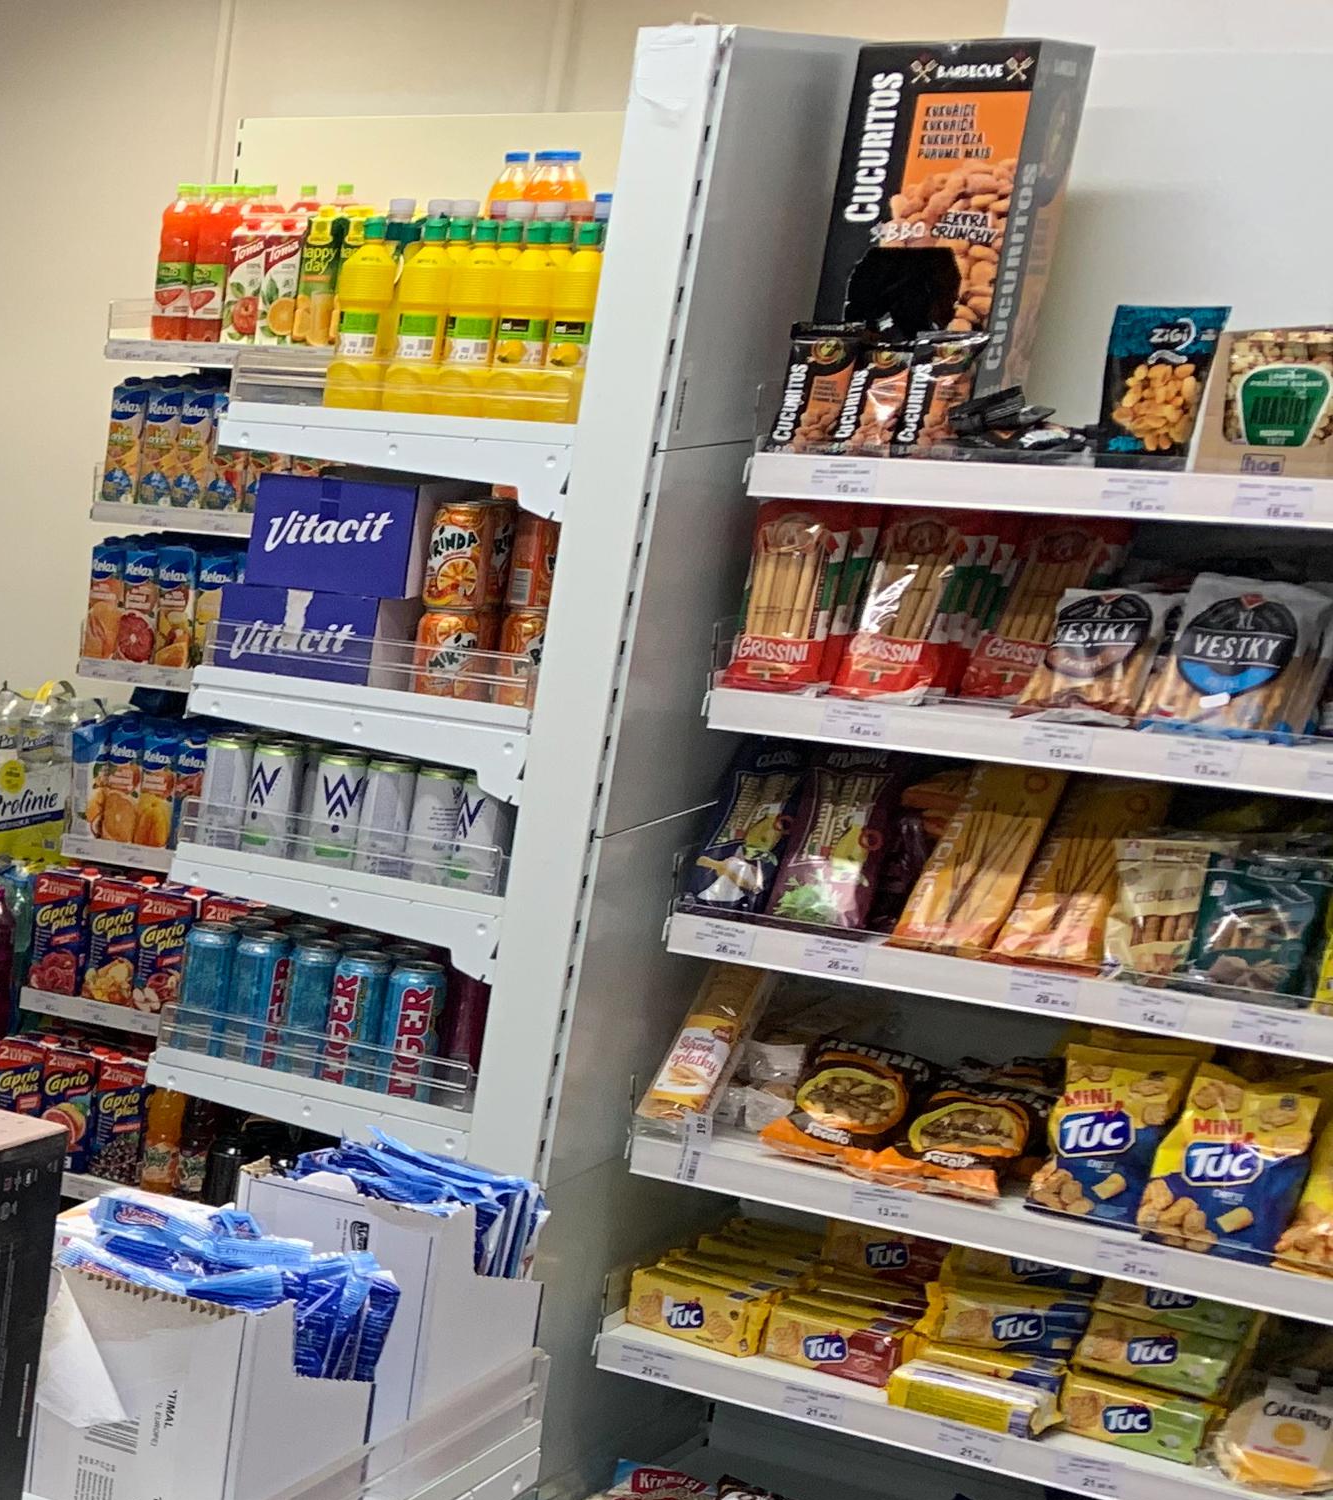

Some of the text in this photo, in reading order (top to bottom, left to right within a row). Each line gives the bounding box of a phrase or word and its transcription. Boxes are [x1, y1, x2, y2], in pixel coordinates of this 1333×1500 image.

[937, 63, 1004, 79] BARBECUE
[844, 71, 904, 223] CUCURITOS
[931, 224, 998, 244] CRUNCHY
[233, 240, 264, 263] Toma
[268, 240, 299, 263] Toma
[305, 259, 329, 275] day
[986, 163, 1037, 371] CUCURITOS
[113, 401, 141, 414] Relax
[149, 401, 180, 417] Relax
[183, 403, 211, 419] Relax
[772, 362, 809, 442] CUCURITOS
[897, 361, 933, 444] CUCURITOS
[264, 511, 394, 553] Vitacit
[93, 559, 117, 576] Relax
[126, 562, 154, 580] Relax
[159, 567, 188, 583] Relax
[200, 568, 232, 586] Relax
[737, 635, 810, 664] GRISSINI
[849, 637, 923, 664] GRISSINI
[1194, 632, 1282, 662] VESTKY
[110, 745, 137, 759] Relax
[143, 751, 171, 765] Relax
[35, 902, 78, 933] Caprio
[50, 912, 77, 934] plus
[91, 909, 135, 935] Caprio
[106, 920, 134, 942] plus
[139, 922, 185, 948] Caprio
[156, 934, 186, 953] plus
[670, 1051, 718, 1074] oplatky
[12, 1080, 39, 1097] plus
[44, 1070, 89, 1097] Caprio
[98, 1089, 140, 1112] Caprio
[113, 1103, 139, 1120] plus
